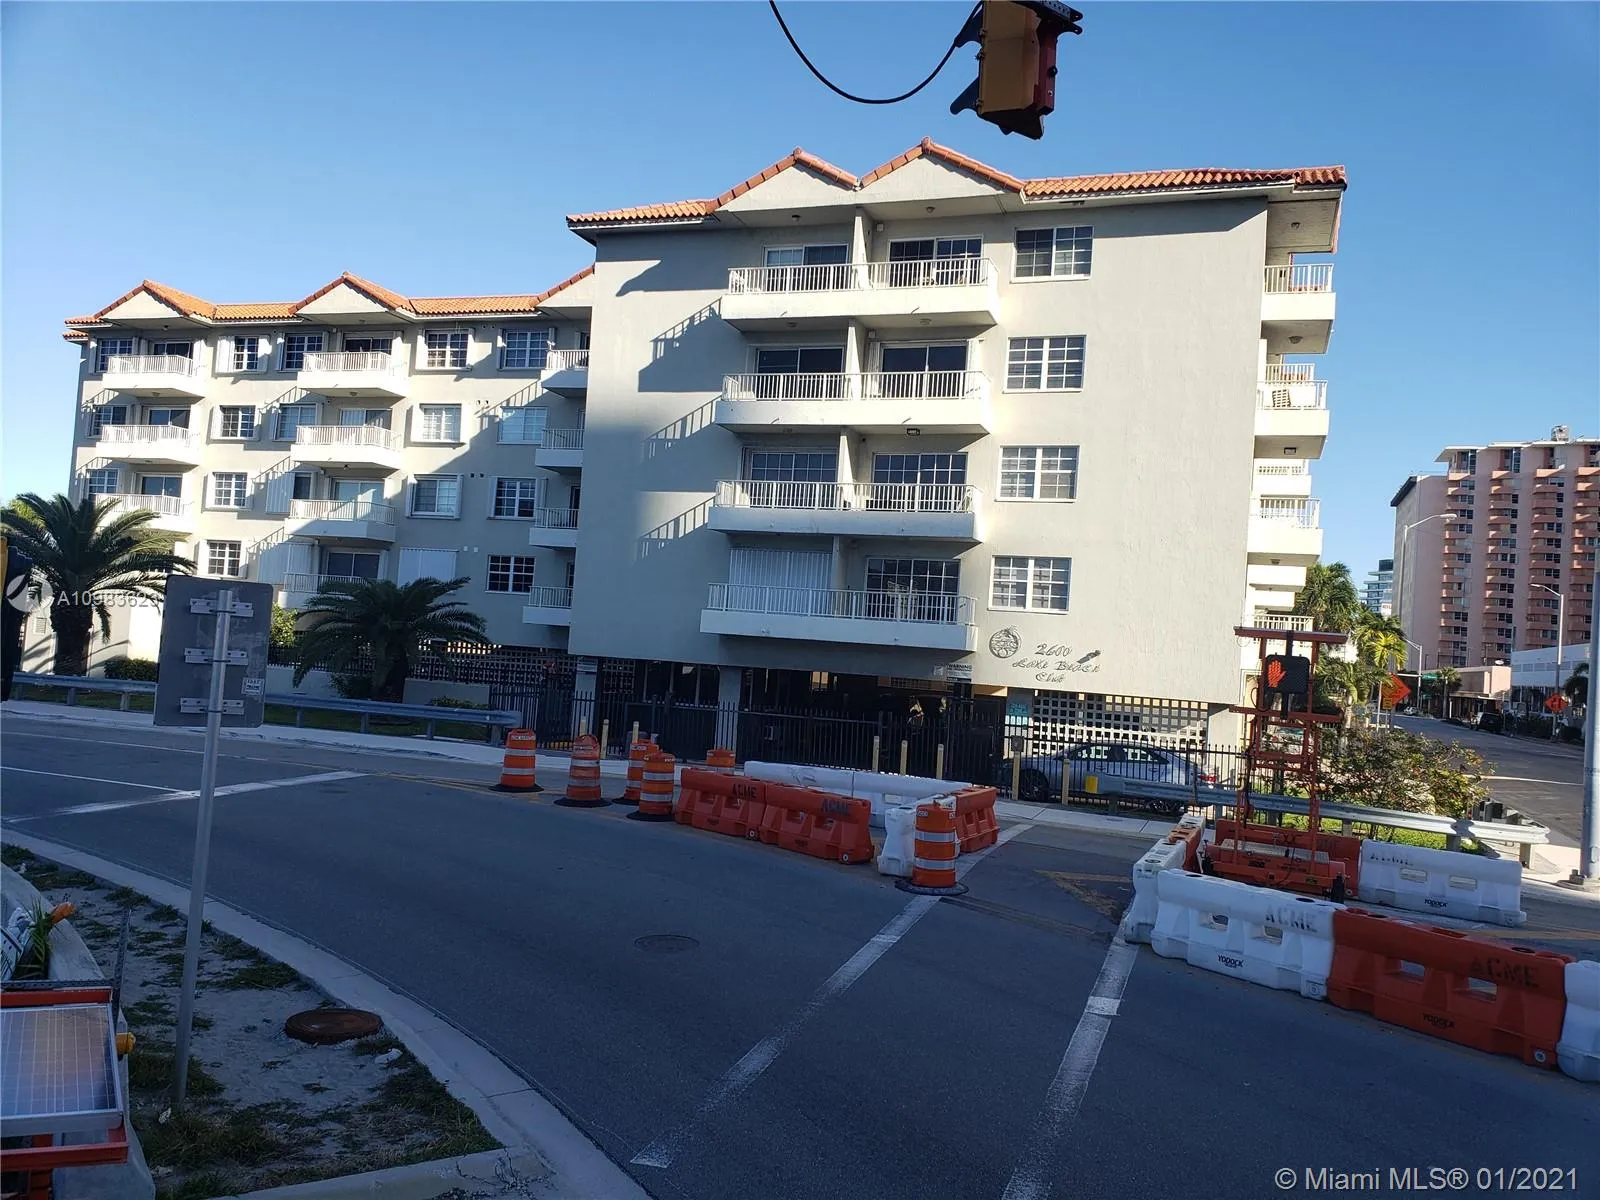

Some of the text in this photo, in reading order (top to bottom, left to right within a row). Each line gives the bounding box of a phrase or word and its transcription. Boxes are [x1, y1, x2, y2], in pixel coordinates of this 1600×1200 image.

[1034, 642, 1072, 657] 2600
[1035, 672, 1065, 683] Club
[732, 783, 757, 799] ACME
[1470, 956, 1540, 988] ACME
